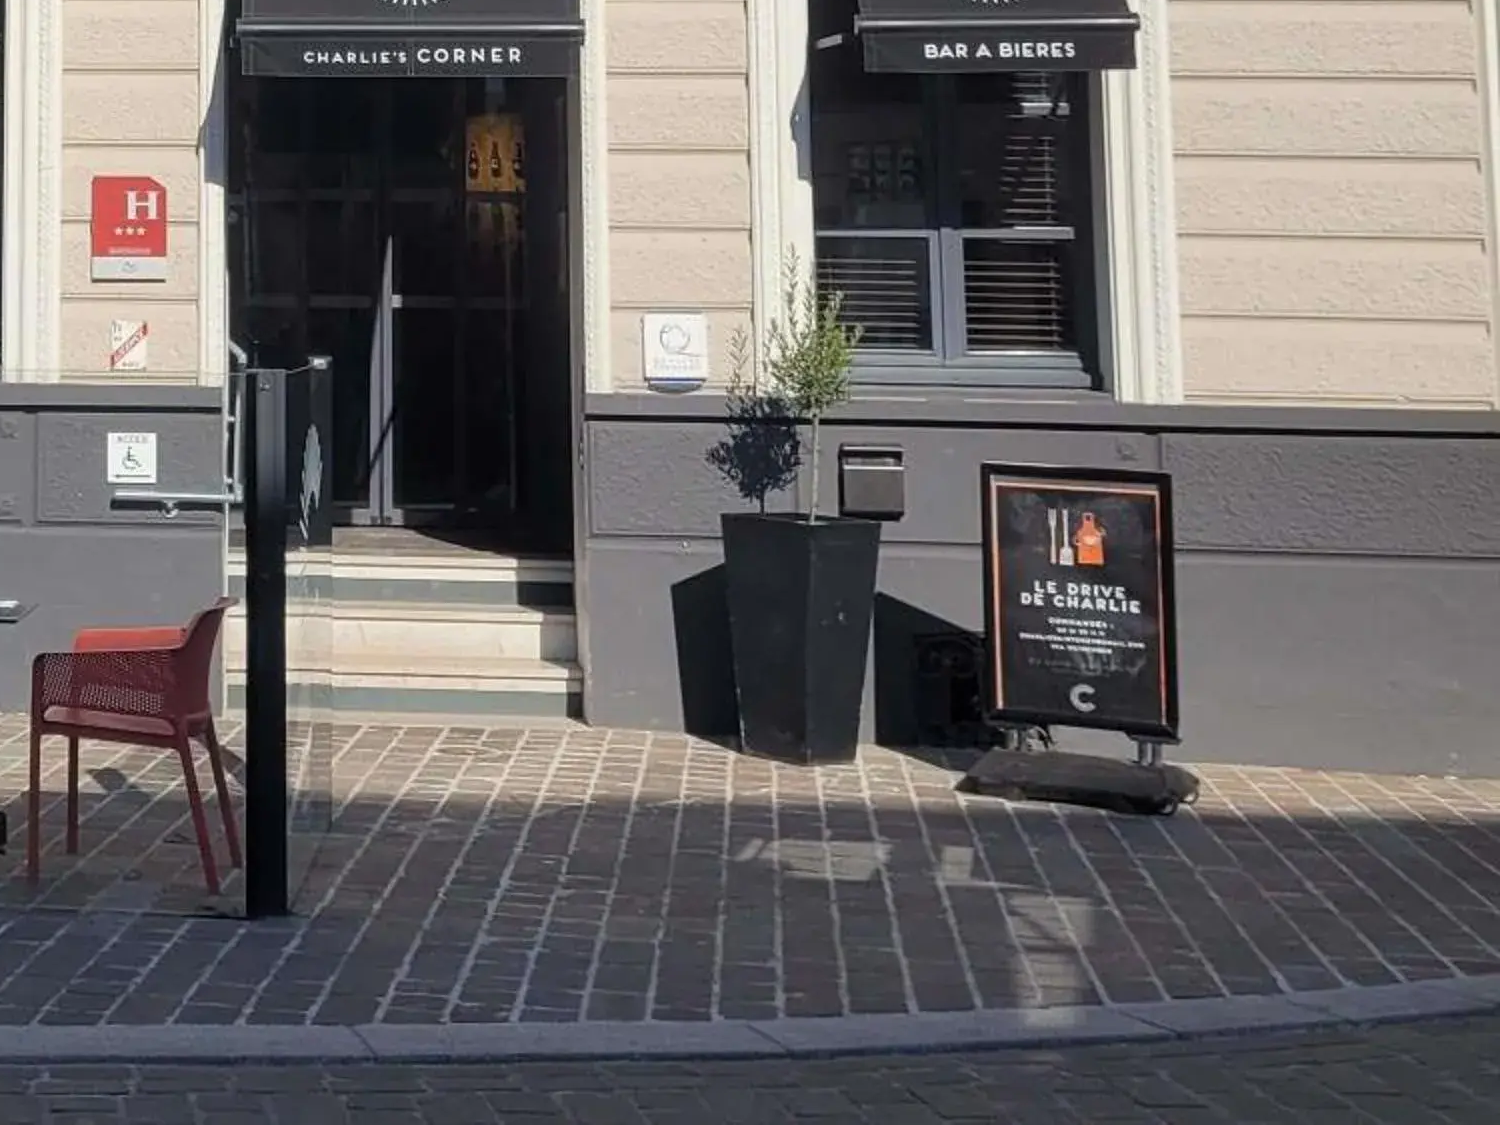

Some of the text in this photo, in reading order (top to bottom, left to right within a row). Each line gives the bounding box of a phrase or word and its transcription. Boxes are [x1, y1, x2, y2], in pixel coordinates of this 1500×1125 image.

[303, 48, 522, 64] CHARLIE'S CORNER
[923, 42, 1076, 59] BAR A BIERES
[125, 190, 161, 220] H
[1033, 579, 1126, 600] LE DRIVE
[1020, 591, 1141, 614] DE CHARLIE
